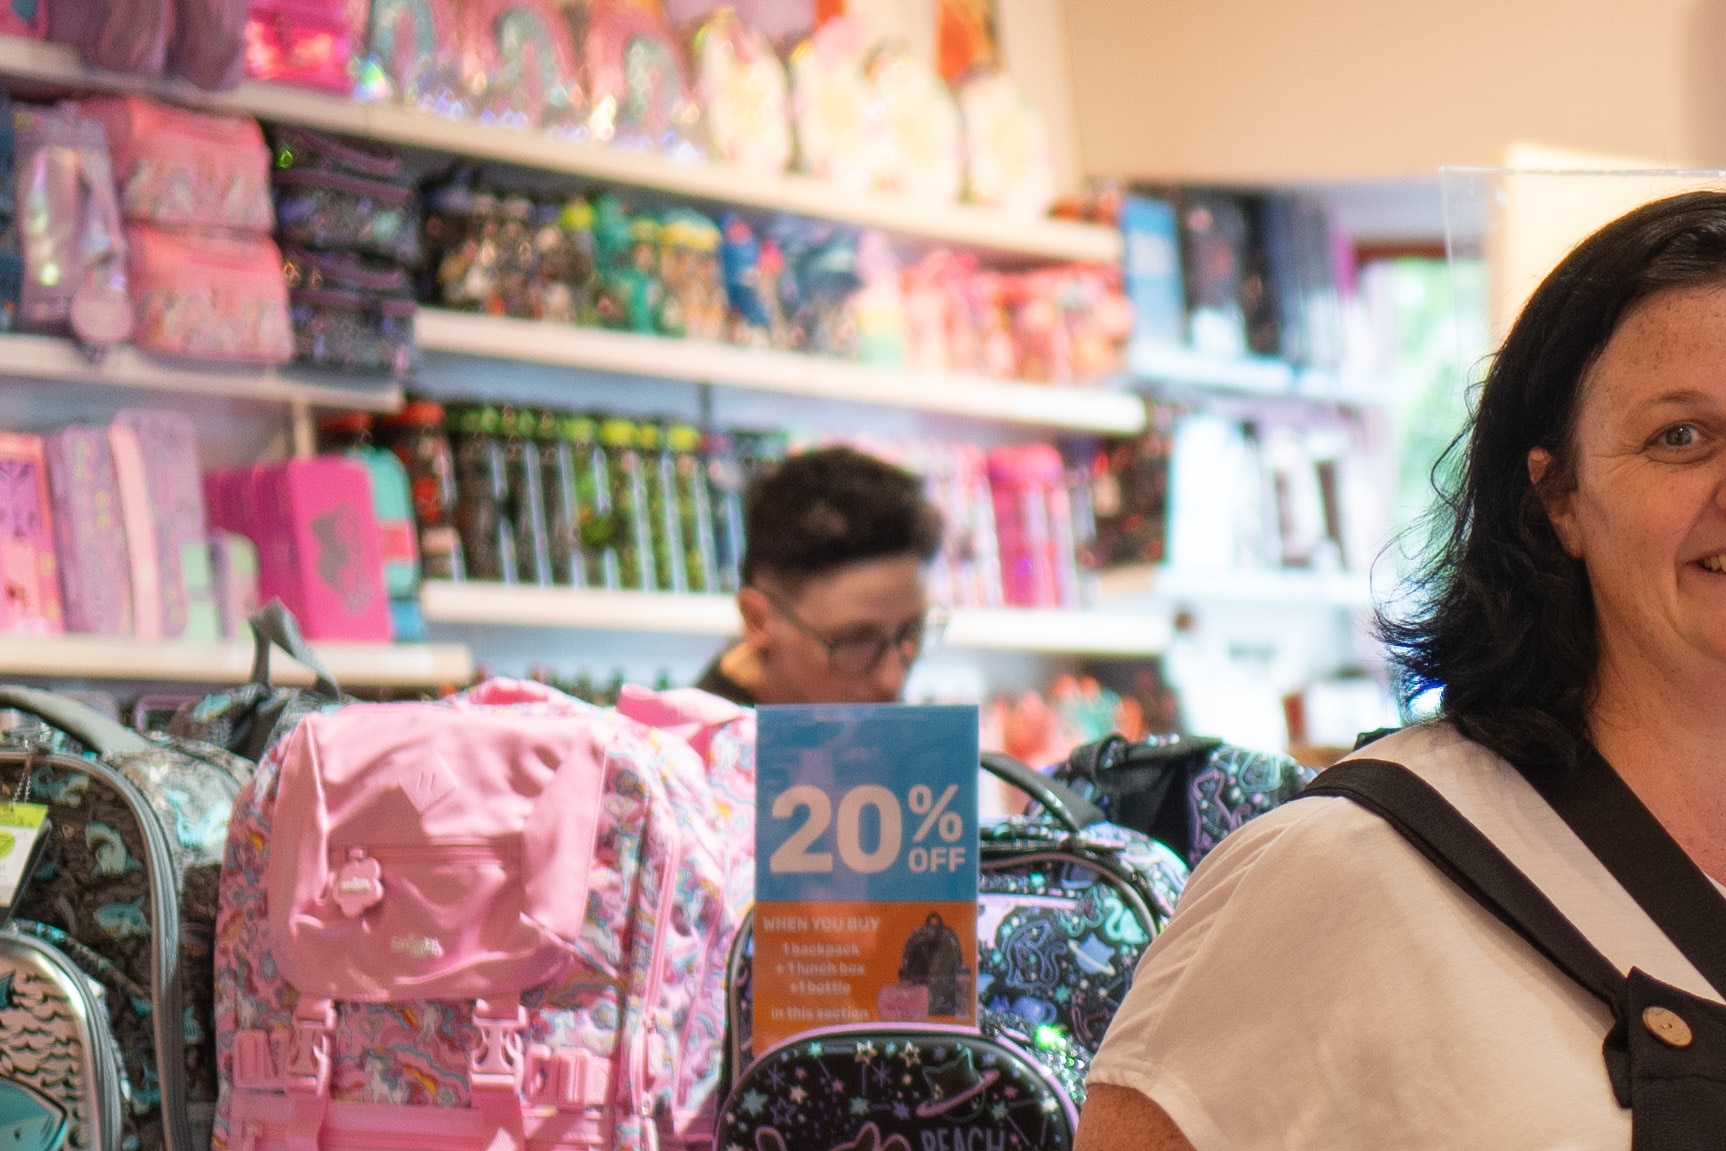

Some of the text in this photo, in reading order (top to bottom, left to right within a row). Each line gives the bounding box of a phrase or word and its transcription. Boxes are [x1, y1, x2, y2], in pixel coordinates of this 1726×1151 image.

[769, 784, 964, 874] 20%
[908, 847, 965, 873] OFF
[763, 916, 879, 932] WHEN YOU BUY
[791, 942, 860, 957] backpack
[797, 961, 837, 975] lunch
[787, 1005, 813, 1019] this
[816, 1005, 869, 1020] section
